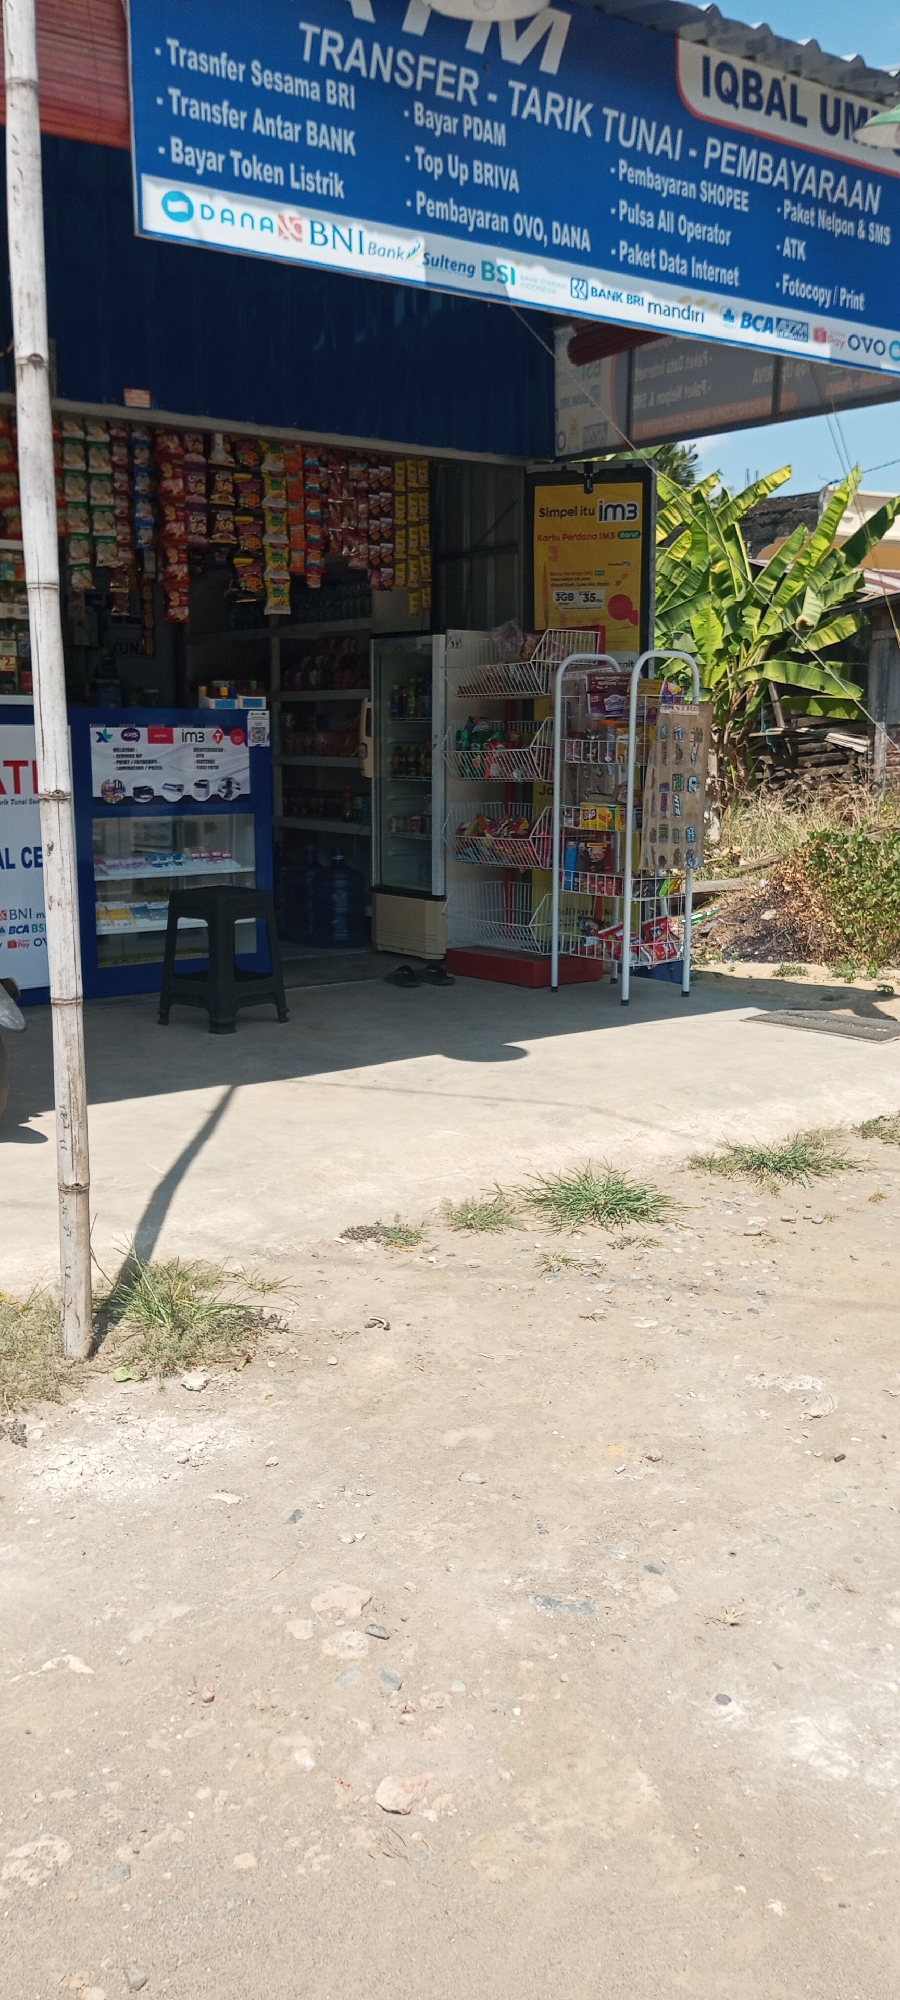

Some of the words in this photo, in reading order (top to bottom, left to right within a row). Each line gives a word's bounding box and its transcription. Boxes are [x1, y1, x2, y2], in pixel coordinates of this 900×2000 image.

[166, 37, 246, 83] Trasnfer
[251, 60, 321, 103] Sesama
[326, 79, 355, 110] BRI
[168, 87, 247, 131] Transfer
[253, 108, 301, 144] Antar
[306, 120, 356, 156] BANK
[299, 21, 480, 106] TRANSFER
[508, 80, 593, 138] TARIK
[602, 106, 683, 161] TUNAI
[704, 136, 881, 215] PEMBAYARAAN
[414, 101, 459, 138] Bayar
[463, 114, 506, 148] PDAM
[702, 55, 808, 128] IQBAL
[820, 93, 878, 149] UM
[171, 136, 225, 176] Bayar
[230, 148, 284, 187] Token
[290, 162, 345, 199] Listrik
[414, 146, 443, 181] Top
[448, 153, 469, 187] Up
[473, 159, 520, 194] BRIVA
[618, 159, 697, 200] Pembayaran
[700, 180, 750, 212] SHOPEE
[201, 203, 274, 234] DANA
[310, 219, 364, 256] BNI
[368, 241, 405, 261] Bank
[422, 252, 476, 278] Sulteng
[481, 260, 516, 286] BSI
[416, 190, 509, 232] Pembayaran
[513, 212, 547, 248] OVO,
[552, 221, 591, 252] DANA
[619, 199, 655, 230] Pulsa
[657, 210, 675, 235] All
[678, 214, 731, 247] Operator
[783, 199, 815, 228] Paket
[818, 206, 855, 238] Nelpon
[857, 219, 866, 240] &
[868, 221, 892, 247] SMS
[619, 240, 656, 271] Paket
[659, 250, 688, 277] Data
[691, 256, 740, 288] Internet
[782, 237, 807, 262] ATK
[782, 274, 831, 309] Fotocopy
[839, 287, 866, 312] Print
[591, 286, 623, 304] BANK
[626, 293, 644, 307] BRI
[647, 301, 705, 323] mandiri
[740, 311, 774, 334] BCA
[847, 334, 886, 356] OVO
[538, 506, 577, 520] Simpel
[580, 505, 595, 517] itu
[598, 500, 638, 522] im3
[537, 533, 560, 543] Kartu
[562, 532, 597, 543] Perdana
[181, 729, 205, 743] im3
[11, 797, 27, 806] Tunai
[9, 907, 32, 921] BNI
[9, 924, 29, 935] BCA
